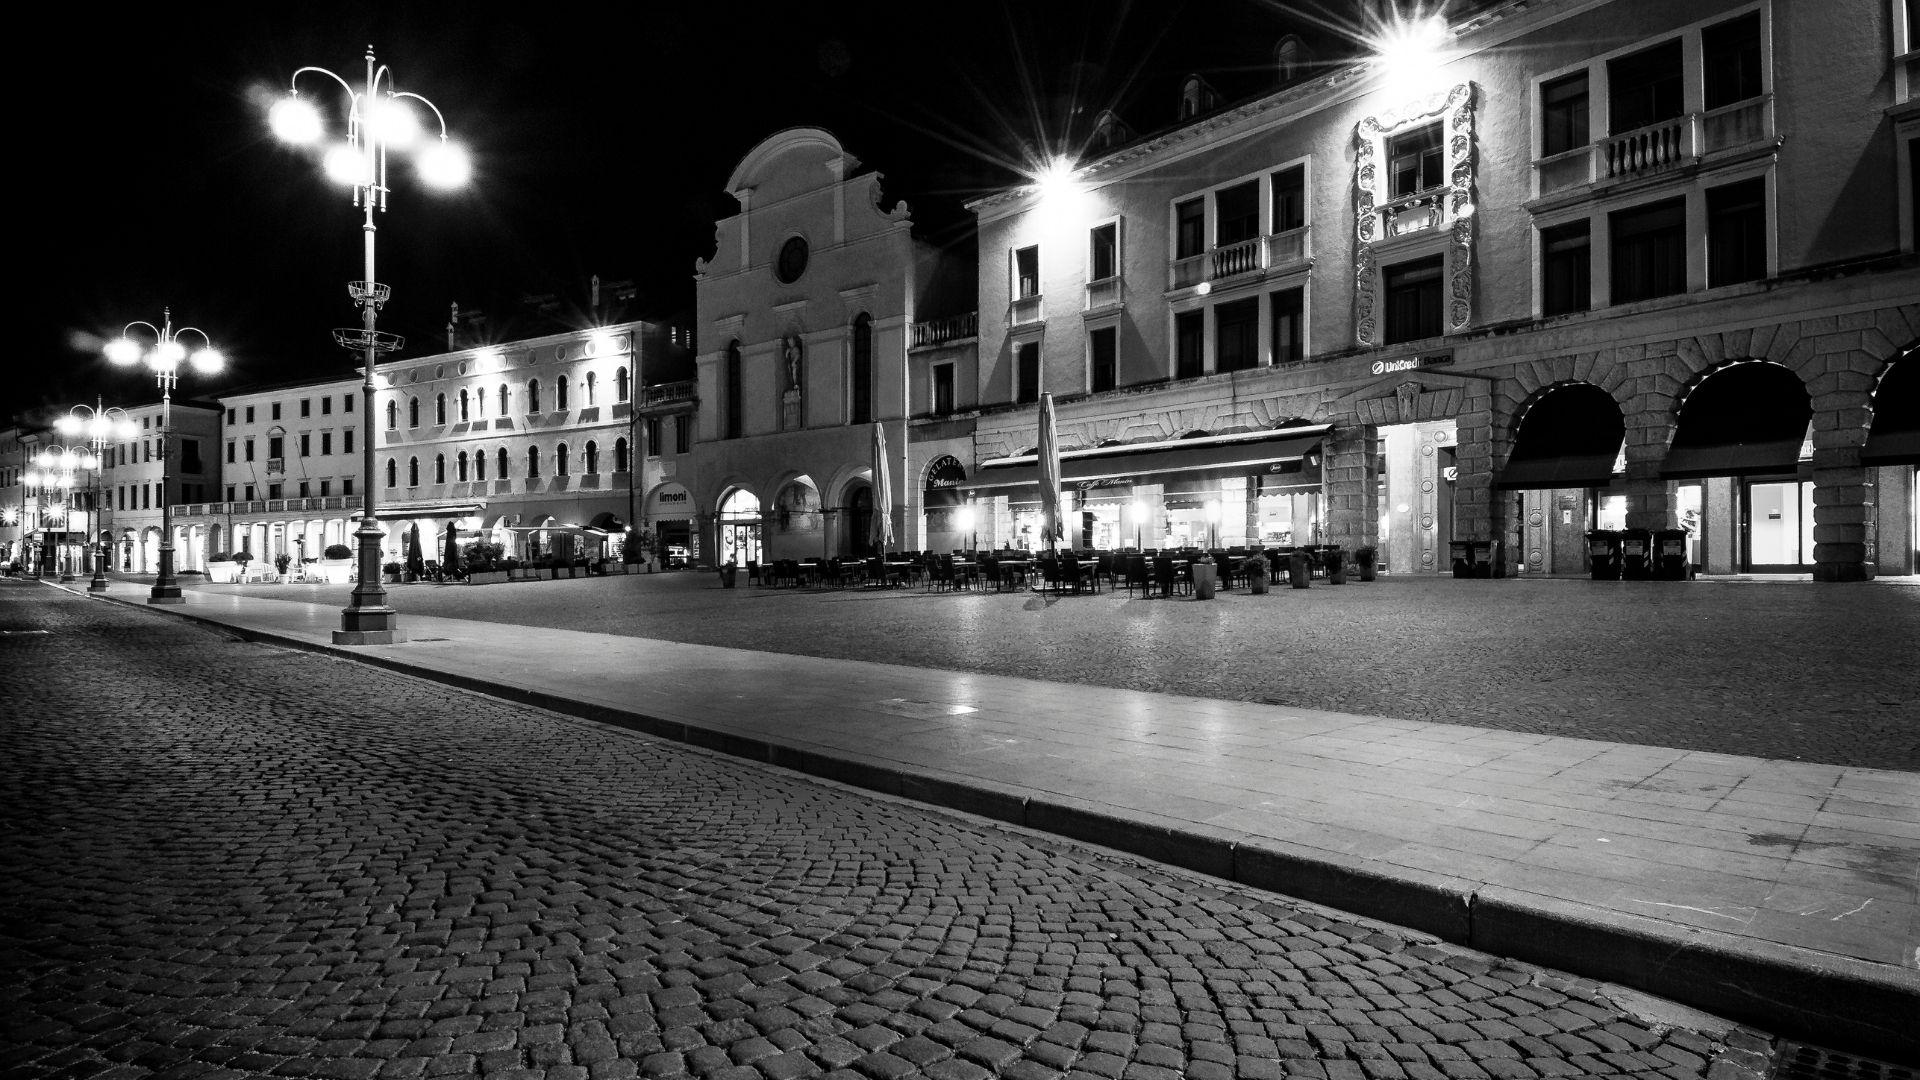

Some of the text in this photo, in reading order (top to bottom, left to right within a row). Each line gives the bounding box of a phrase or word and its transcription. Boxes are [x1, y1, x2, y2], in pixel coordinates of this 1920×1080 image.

[1385, 356, 1421, 373] UniCredi
[928, 457, 966, 481] GELATE
[659, 489, 687, 502] limoni
